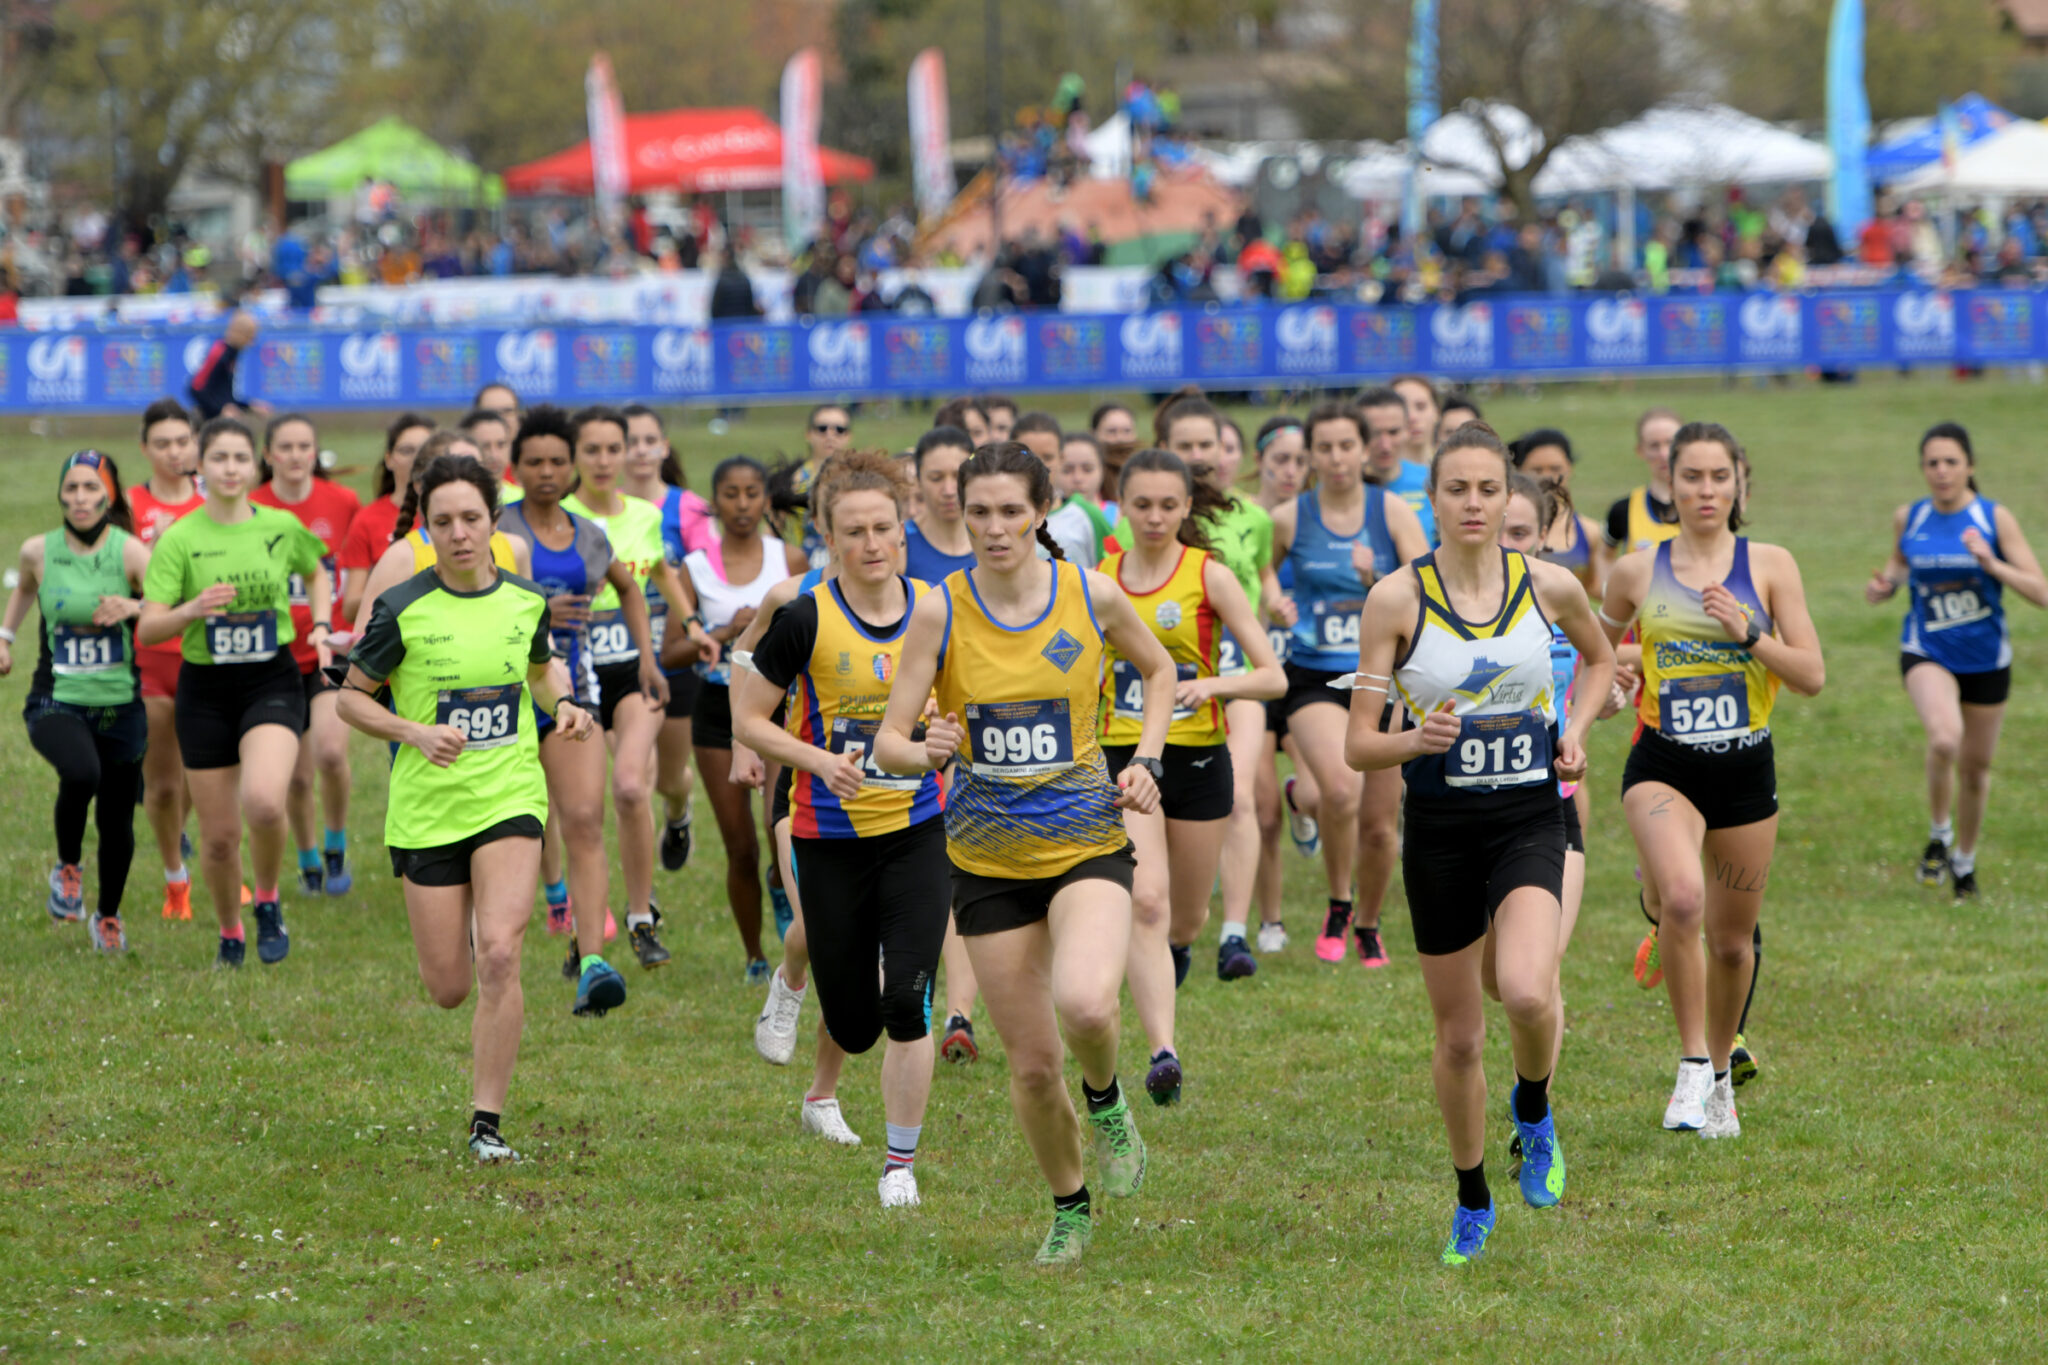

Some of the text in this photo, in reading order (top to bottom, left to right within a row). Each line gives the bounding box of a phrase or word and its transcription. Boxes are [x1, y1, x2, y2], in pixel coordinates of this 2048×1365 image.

[1929, 590, 1979, 621] 100
[214, 624, 265, 655] 591
[586, 622, 629, 653] 20
[1324, 615, 1361, 645] 64
[63, 637, 112, 666] 151
[1654, 640, 1710, 655] CHIMICA
[1656, 651, 1737, 669] ECOLOGICA
[448, 703, 510, 740] 693
[1671, 695, 1738, 732] 520
[982, 723, 1057, 763] 996
[1460, 733, 1532, 774] 913
[1737, 726, 1771, 750] NIK
[843, 740, 904, 778] 54
